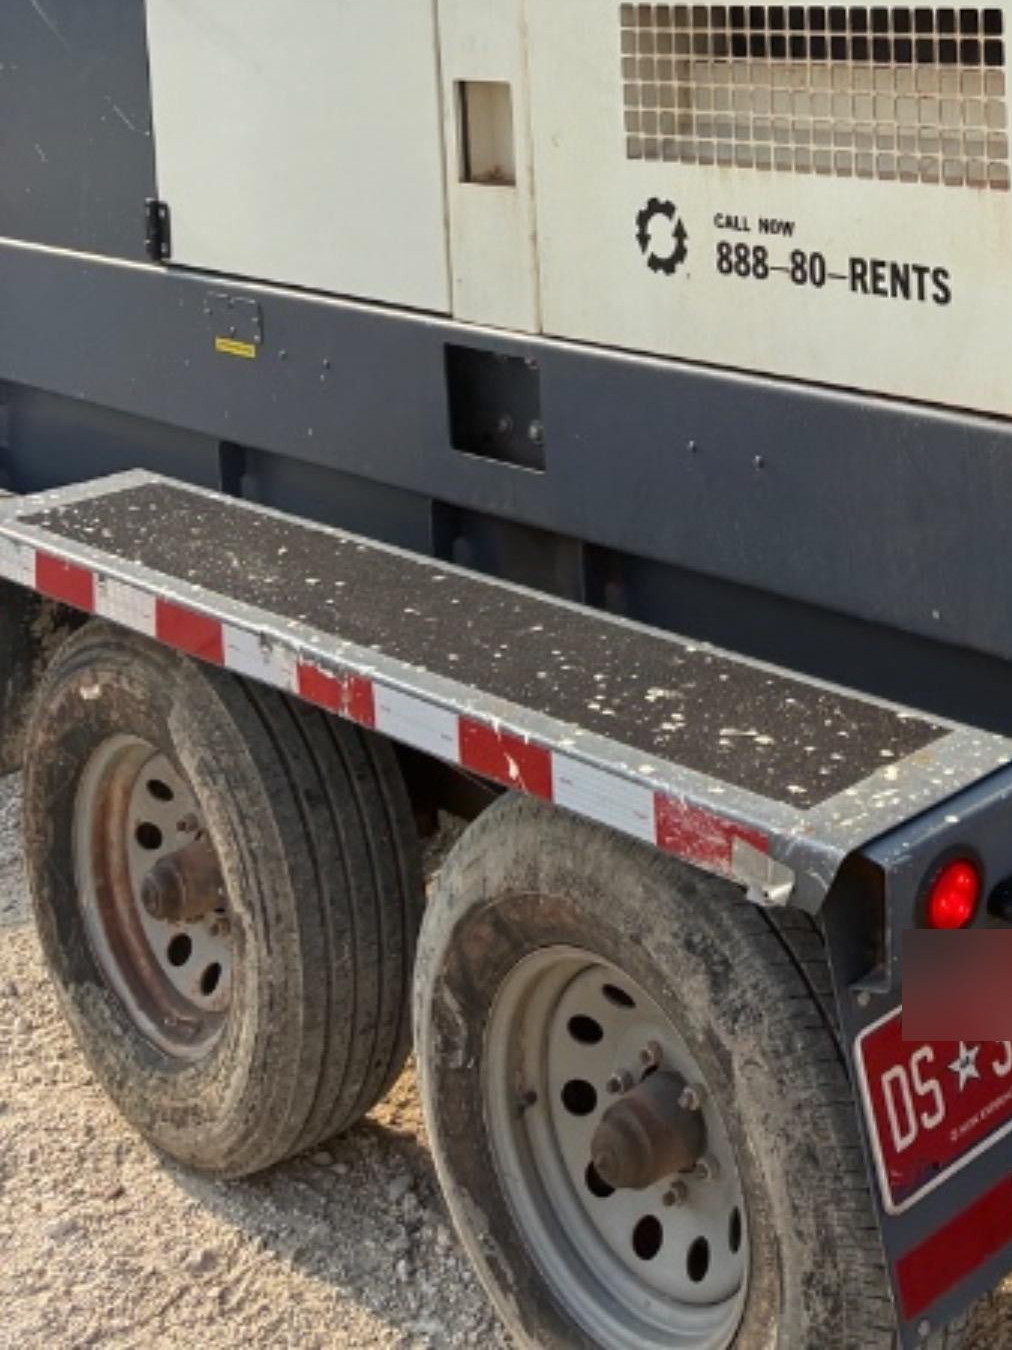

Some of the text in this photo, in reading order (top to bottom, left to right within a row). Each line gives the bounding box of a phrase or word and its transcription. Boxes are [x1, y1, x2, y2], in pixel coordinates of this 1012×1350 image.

[714, 212, 796, 238] CALL NOW
[715, 240, 952, 306] 888-80-RENTS
